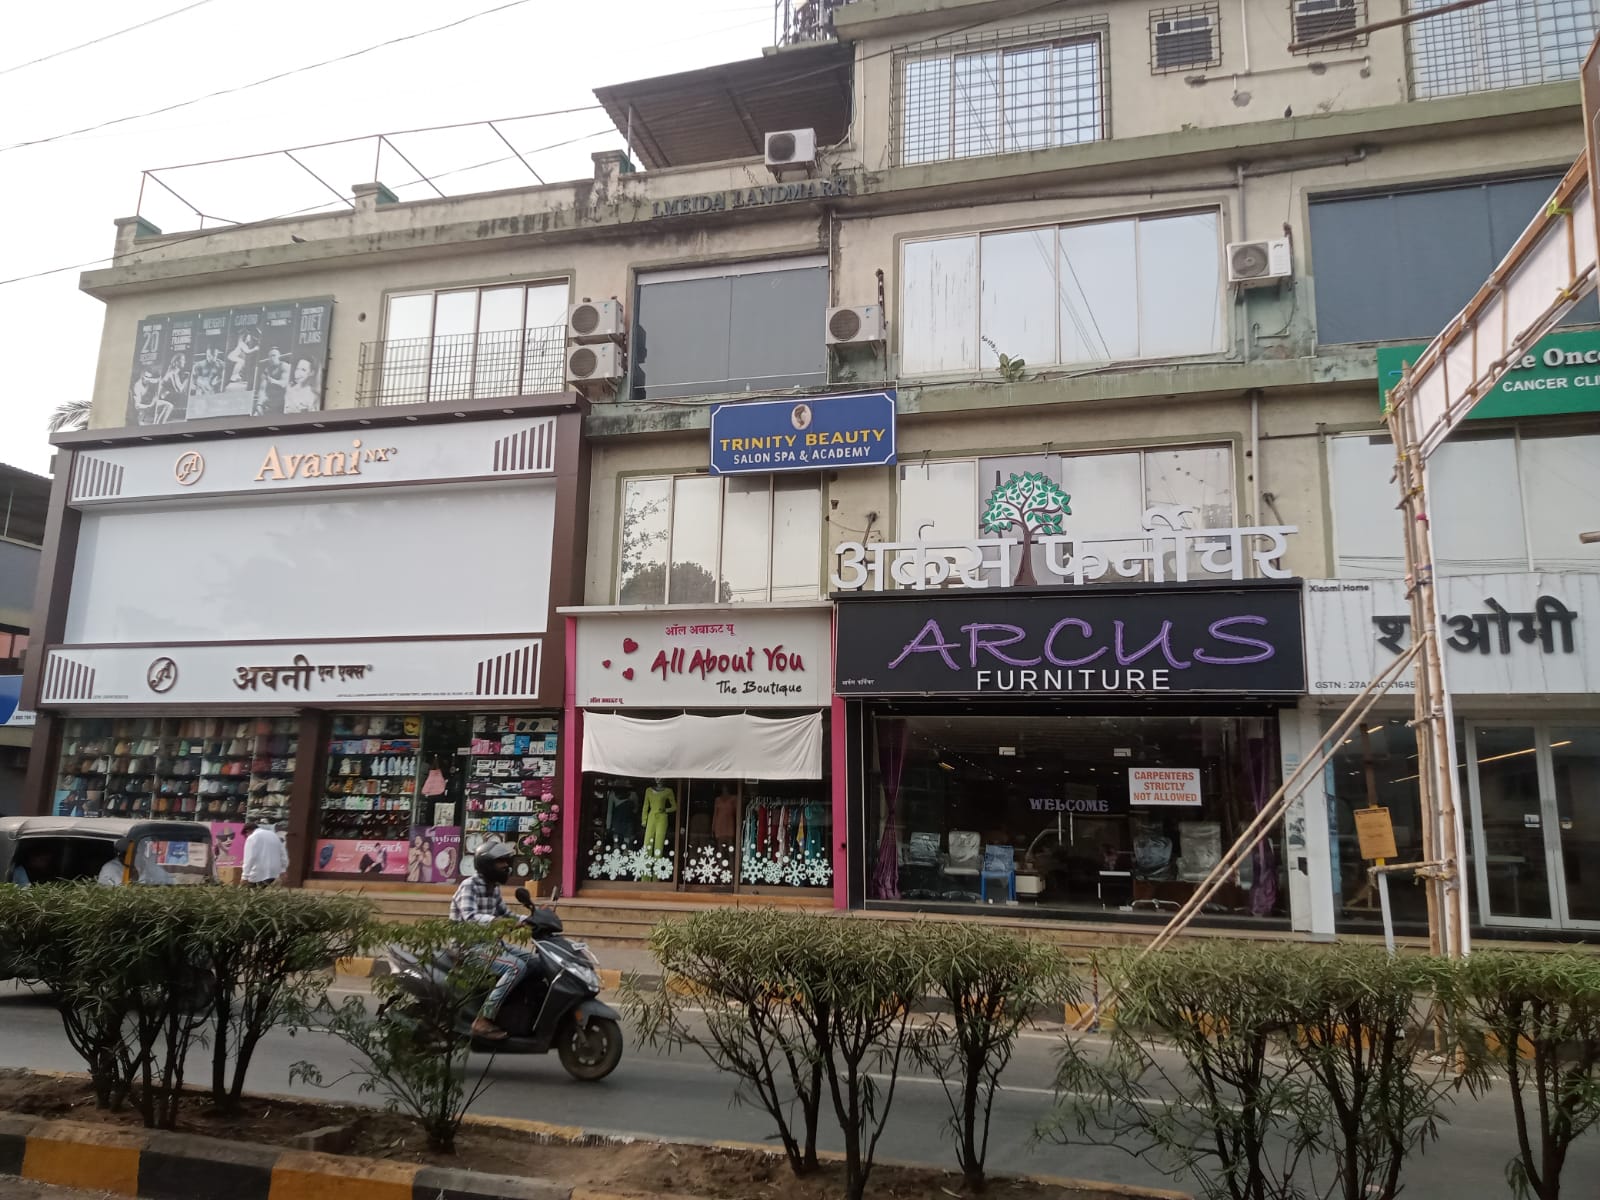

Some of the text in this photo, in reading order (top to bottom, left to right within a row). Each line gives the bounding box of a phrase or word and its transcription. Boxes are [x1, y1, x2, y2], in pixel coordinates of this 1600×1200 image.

[732, 176, 849, 209] LANDMARK
[1543, 347, 1600, 366] Onc
[1502, 377, 1568, 392] CANCER
[719, 428, 886, 452] TRINITY BEAUTY
[253, 438, 362, 482] Avani
[733, 446, 871, 464] SALON SPA & ACADEMY
[1309, 584, 1369, 592] Xiaomi Home
[887, 614, 1276, 671] ARCUS
[650, 644, 806, 681] All About You
[232, 654, 316, 692] अवनी
[976, 668, 1170, 691] FURNITURE
[715, 680, 803, 695] The Boutique
[1315, 681, 1341, 689] GSTN
[1134, 771, 1194, 781] CARPENTERS
[1143, 781, 1186, 791] STRICTLY
[1028, 798, 1109, 812] WELCOME
[1133, 792, 1197, 802] NOT ALLOWED
